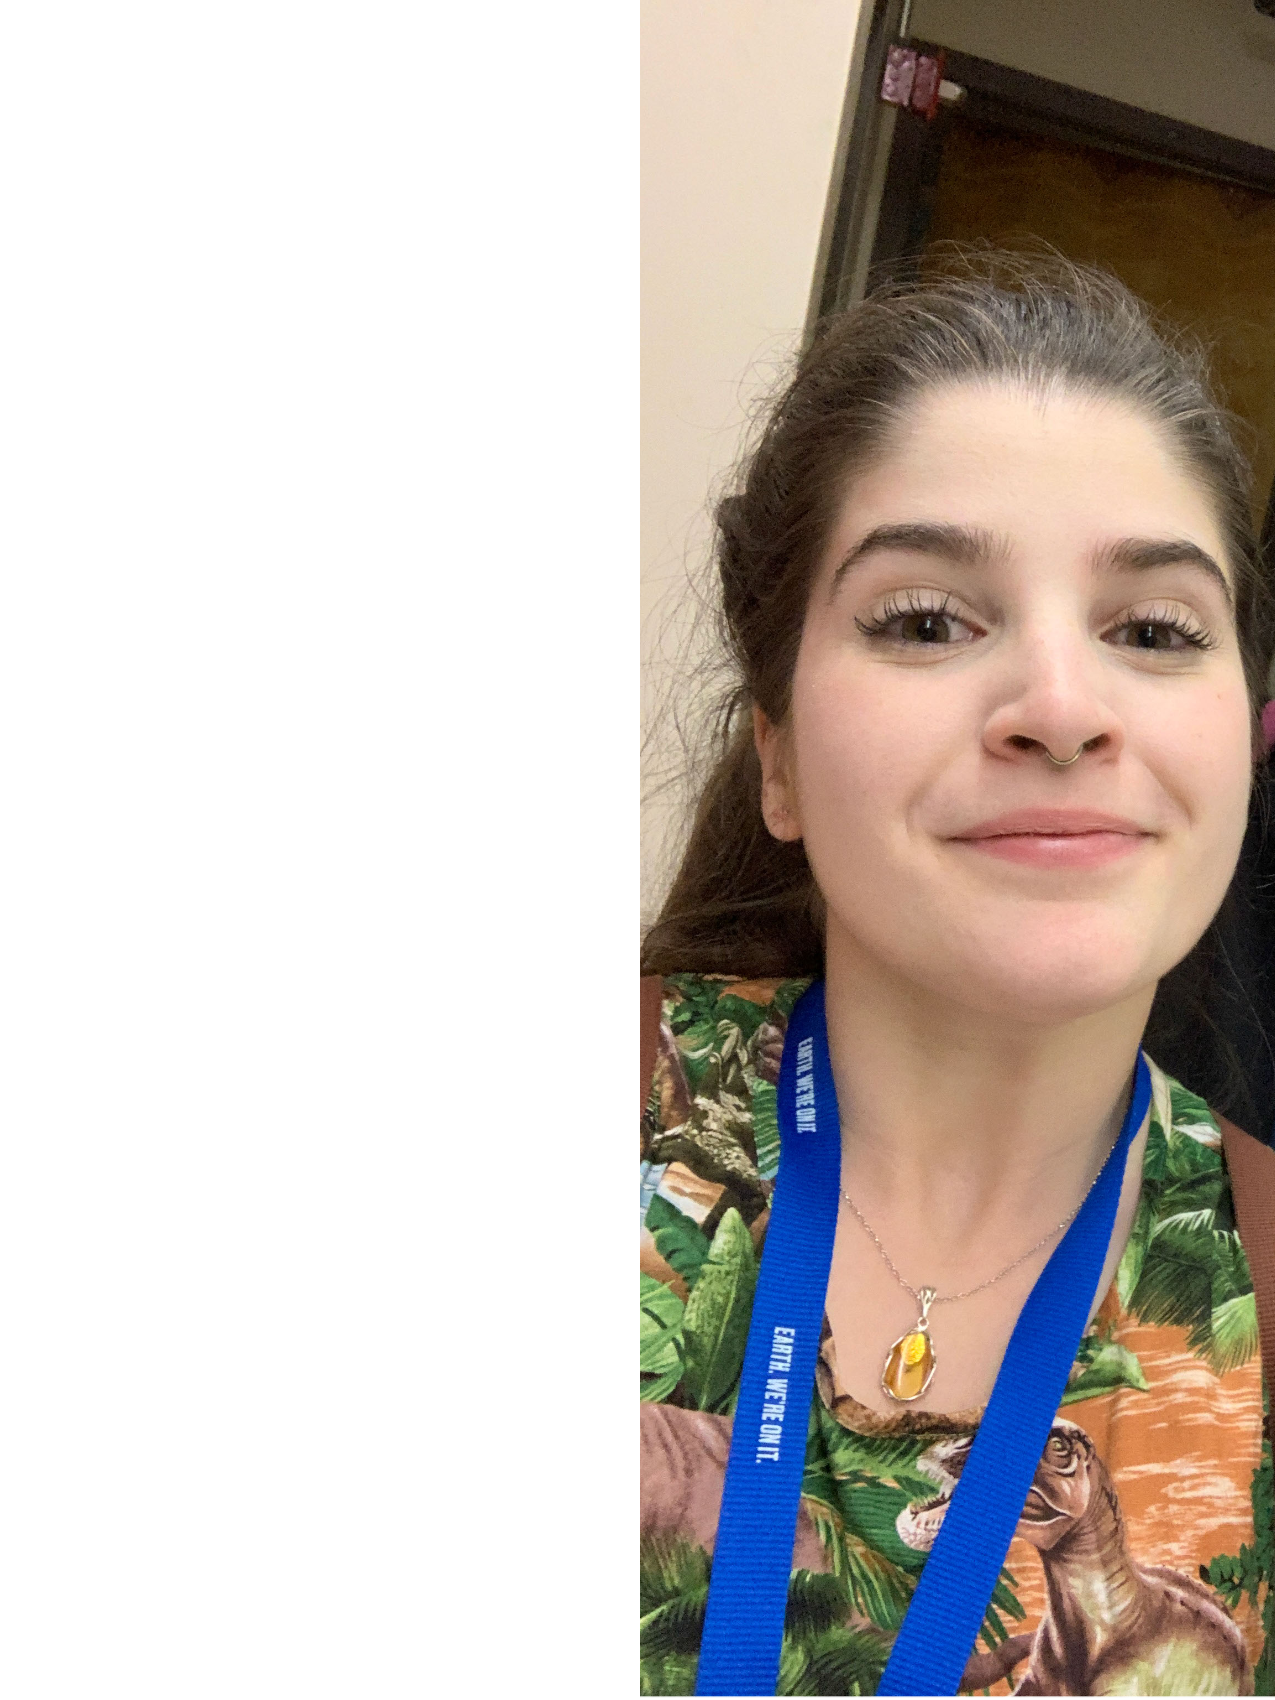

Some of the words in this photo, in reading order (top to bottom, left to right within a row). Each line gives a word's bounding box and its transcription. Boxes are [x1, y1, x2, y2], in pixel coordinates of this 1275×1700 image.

[768, 1326, 796, 1374] EARTH.
[761, 1378, 789, 1422] WE'RE
[758, 1424, 783, 1445] ON
[755, 1446, 780, 1464] IT.
